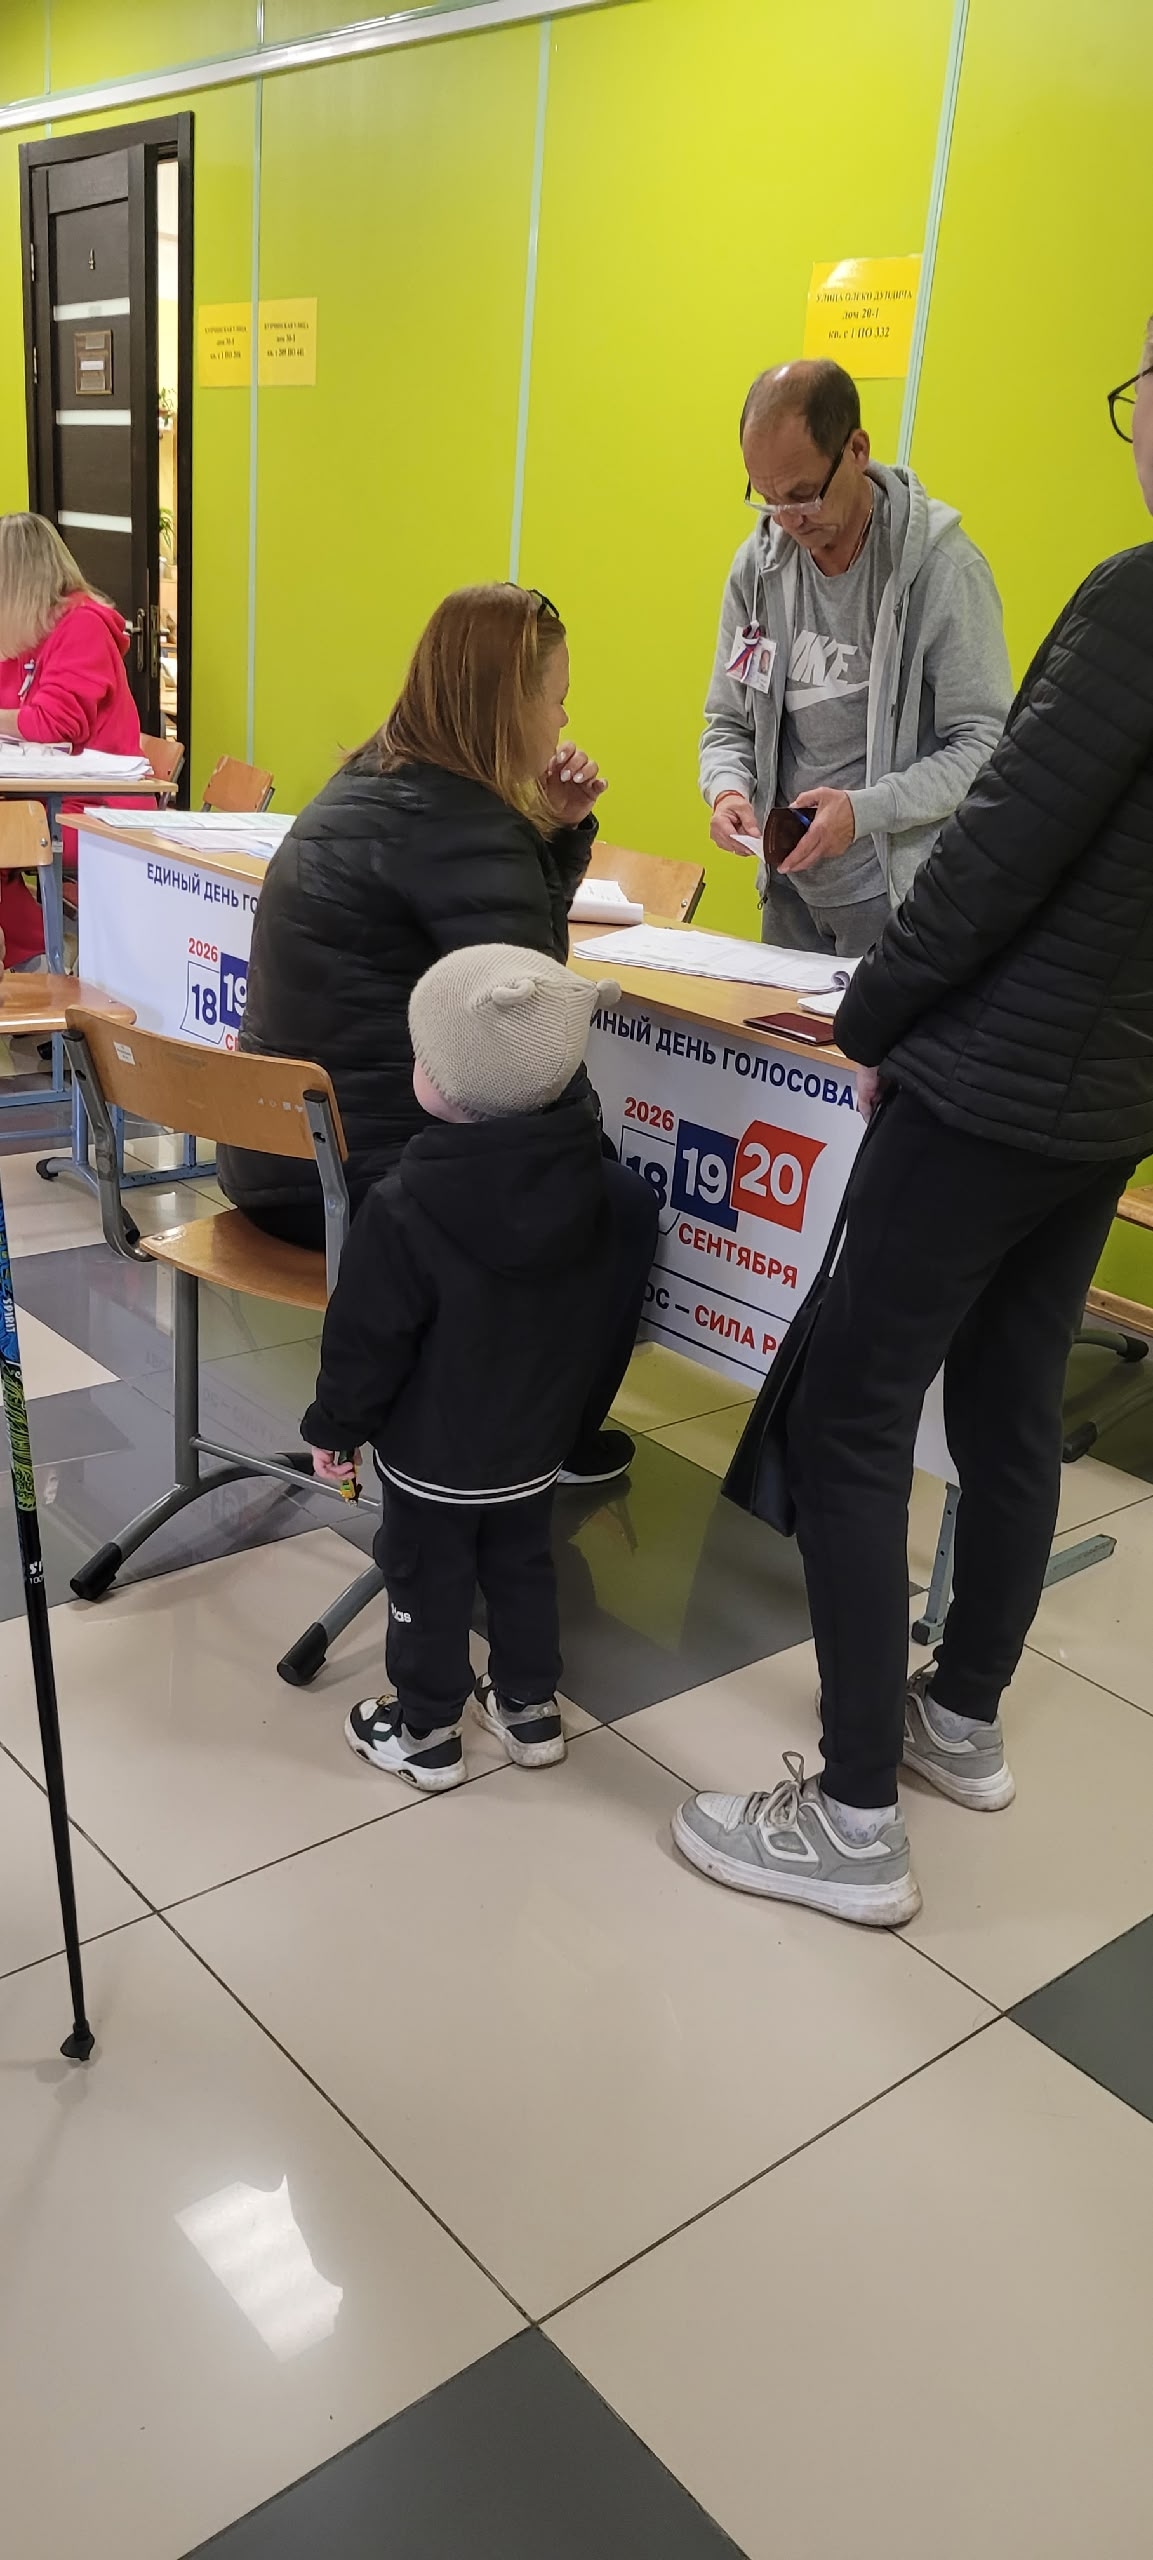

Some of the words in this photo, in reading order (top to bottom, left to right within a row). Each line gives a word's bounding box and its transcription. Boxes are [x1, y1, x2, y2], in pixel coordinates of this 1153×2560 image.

[816, 293, 843, 303] УЛИЦА
[842, 311, 859, 320] дом
[861, 307, 879, 319] 20-1
[857, 327, 873, 339] ПО
[147, 862, 201, 896] ЕДИНЫЙ
[203, 881, 240, 908] ДЕНЬ
[188, 937, 219, 962] 2026
[191, 984, 218, 1026] 18
[223, 973, 247, 1017] 19
[655, 1027, 717, 1066] ДЕНЬ
[722, 1048, 860, 1113] ГОЛОСОВА
[624, 1096, 676, 1132] 2026
[682, 1147, 728, 1205] 19
[739, 1142, 804, 1206] 20
[678, 1222, 798, 1289] СЕНТЯБРЯ
[3, 1297, 16, 1333] SPIRIT
[694, 1304, 756, 1350] СИЛА
